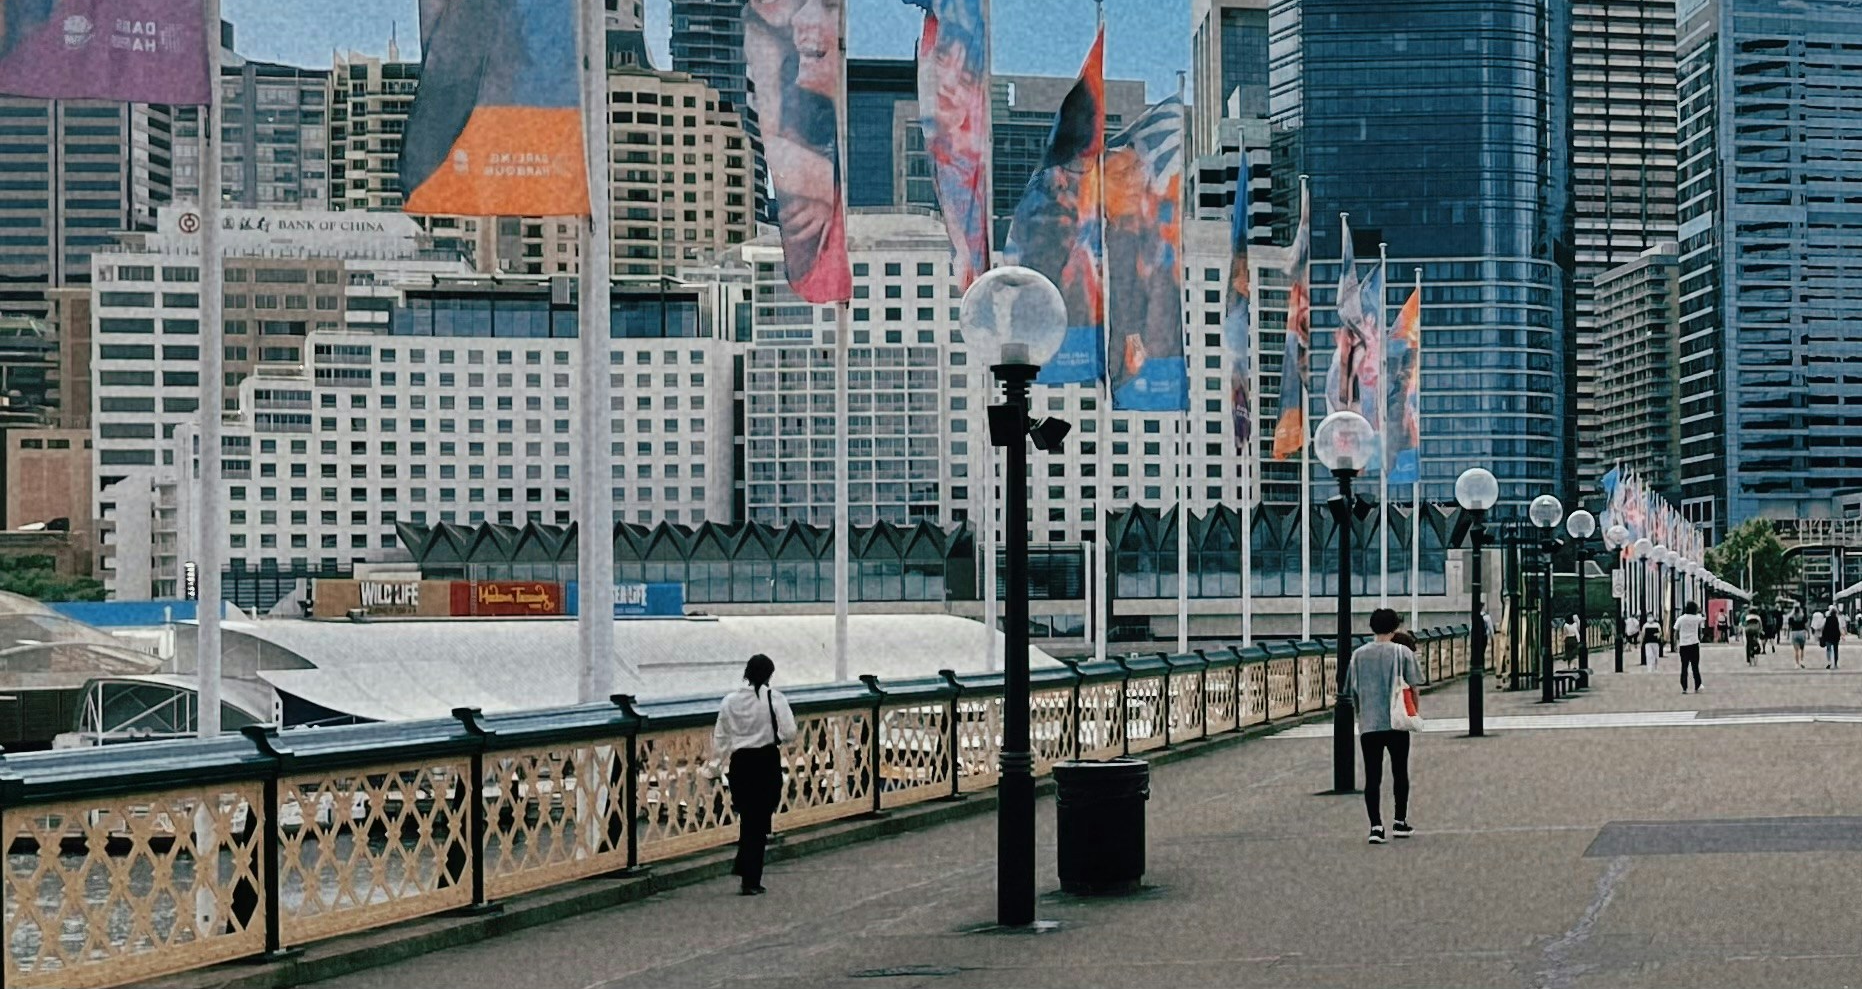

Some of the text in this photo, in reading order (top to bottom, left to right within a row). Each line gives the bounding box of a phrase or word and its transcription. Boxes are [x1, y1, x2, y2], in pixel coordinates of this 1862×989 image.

[279, 220, 385, 232] BANK OF CHINA
[395, 582, 419, 606] LIFE
